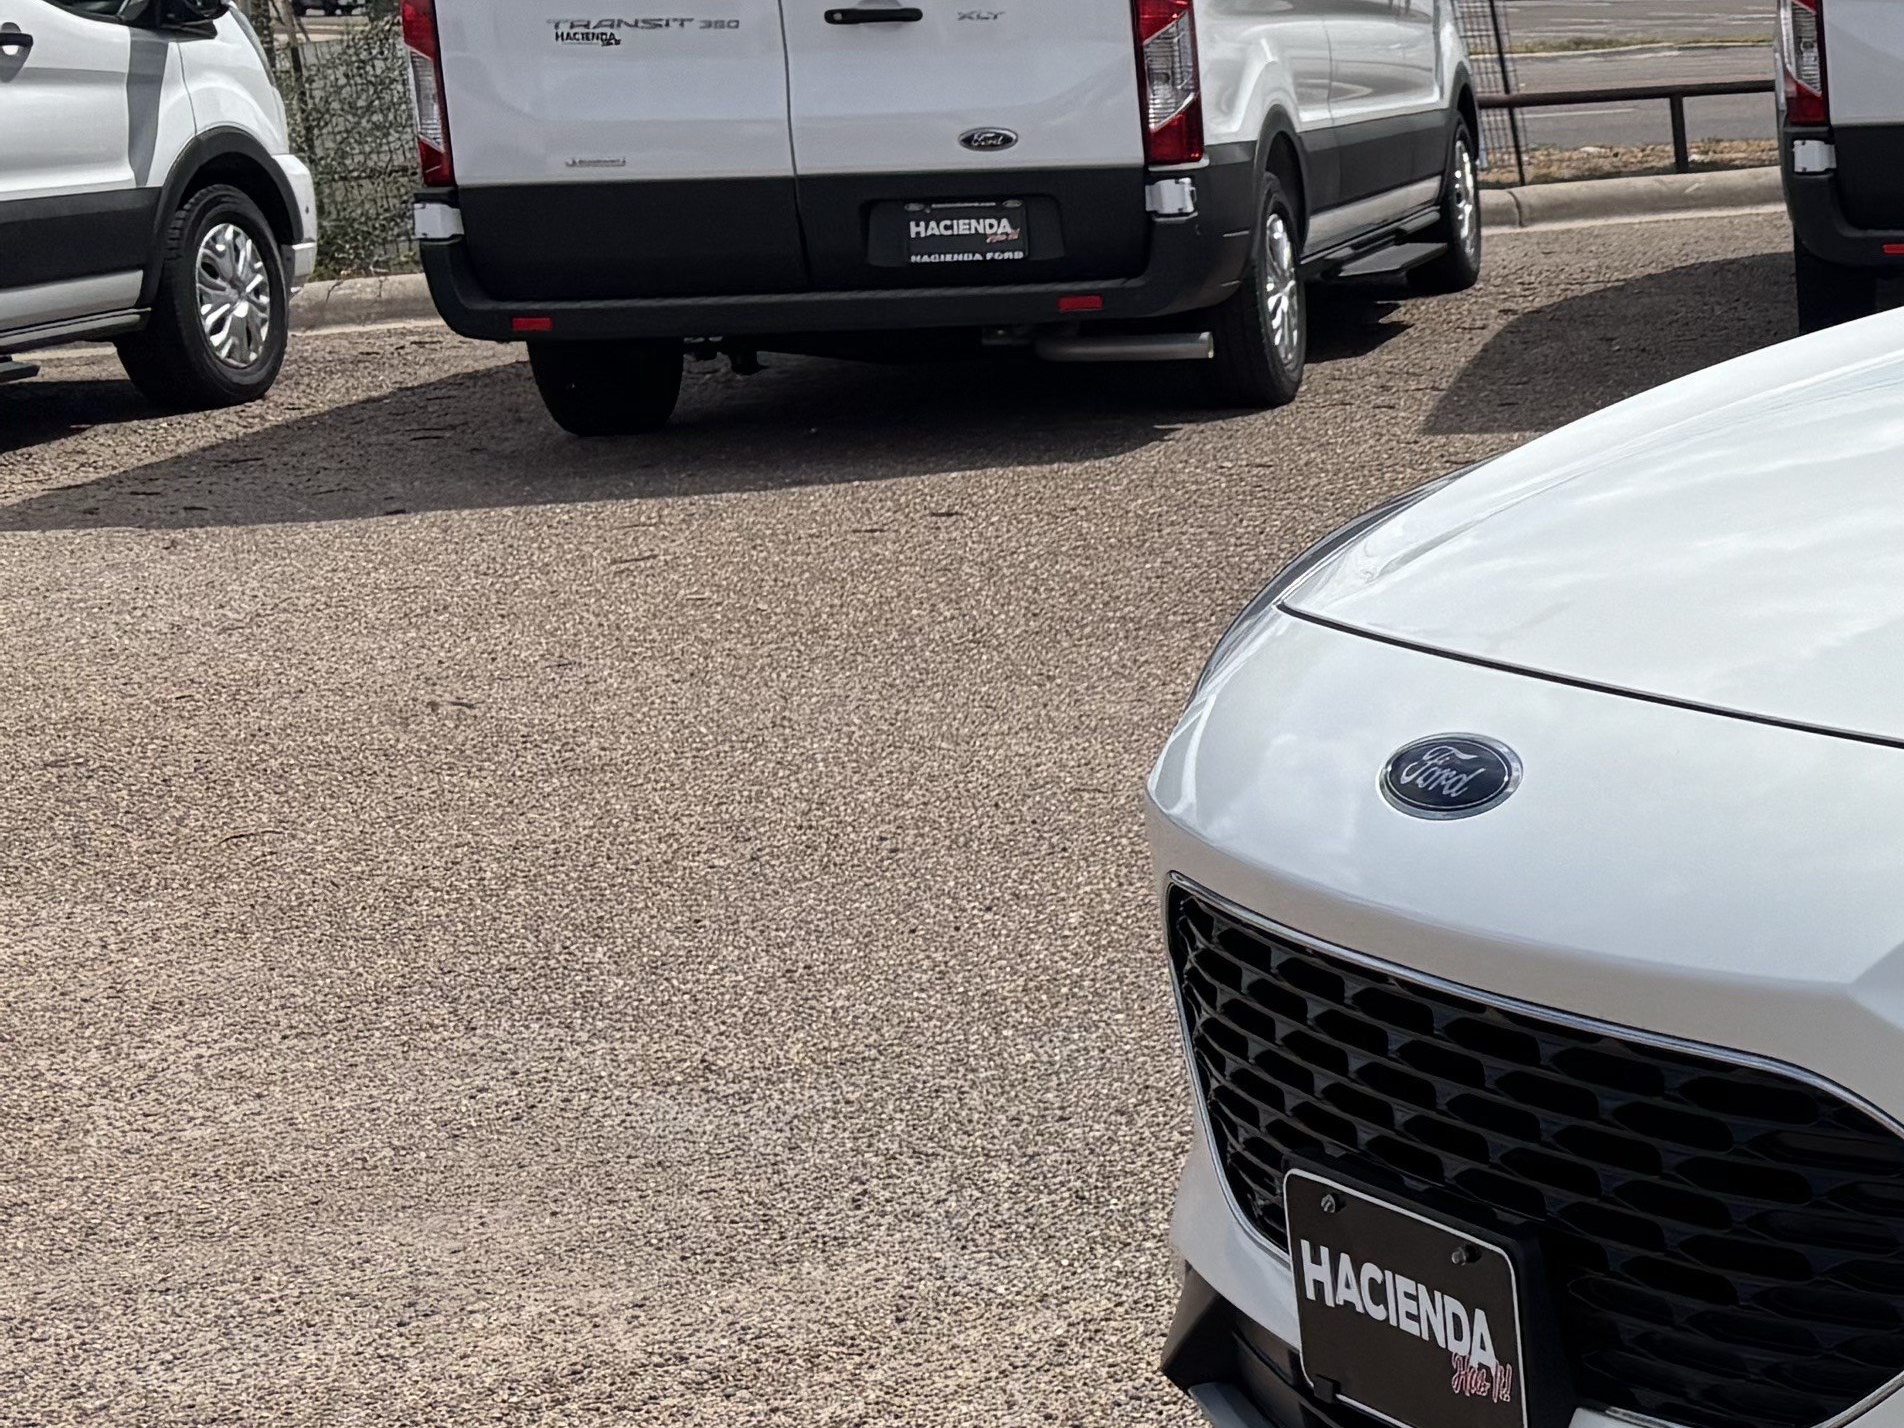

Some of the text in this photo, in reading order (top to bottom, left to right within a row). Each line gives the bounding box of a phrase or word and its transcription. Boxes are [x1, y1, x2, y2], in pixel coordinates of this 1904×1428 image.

[546, 17, 695, 31] TRANSIT
[909, 218, 1012, 238] HACIENDA
[1300, 1238, 1498, 1372] HACIENDA
